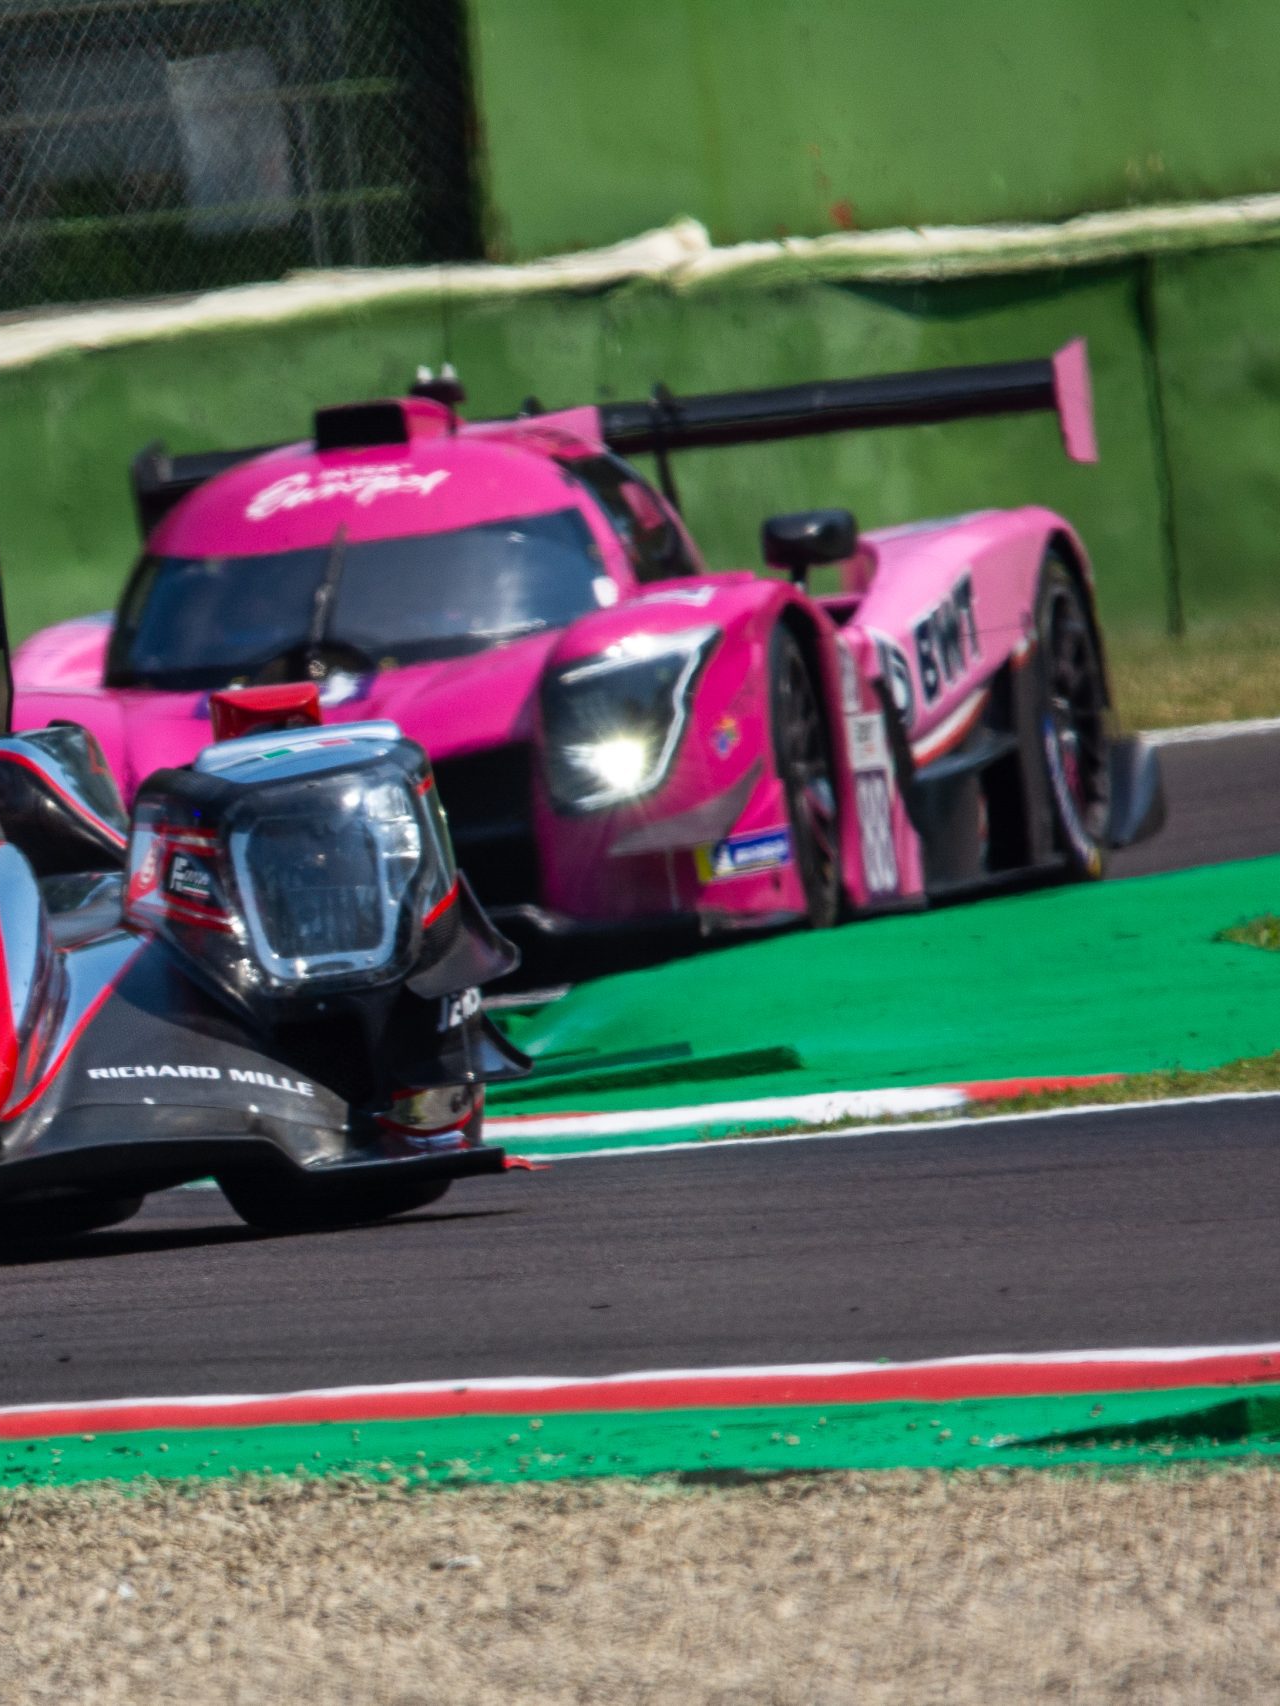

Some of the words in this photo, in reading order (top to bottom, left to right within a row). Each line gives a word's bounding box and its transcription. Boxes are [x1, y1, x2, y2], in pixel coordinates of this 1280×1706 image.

[915, 572, 980, 703] BWT
[87, 1065, 221, 1080] RICHARD
[229, 1069, 315, 1097] MILLE
